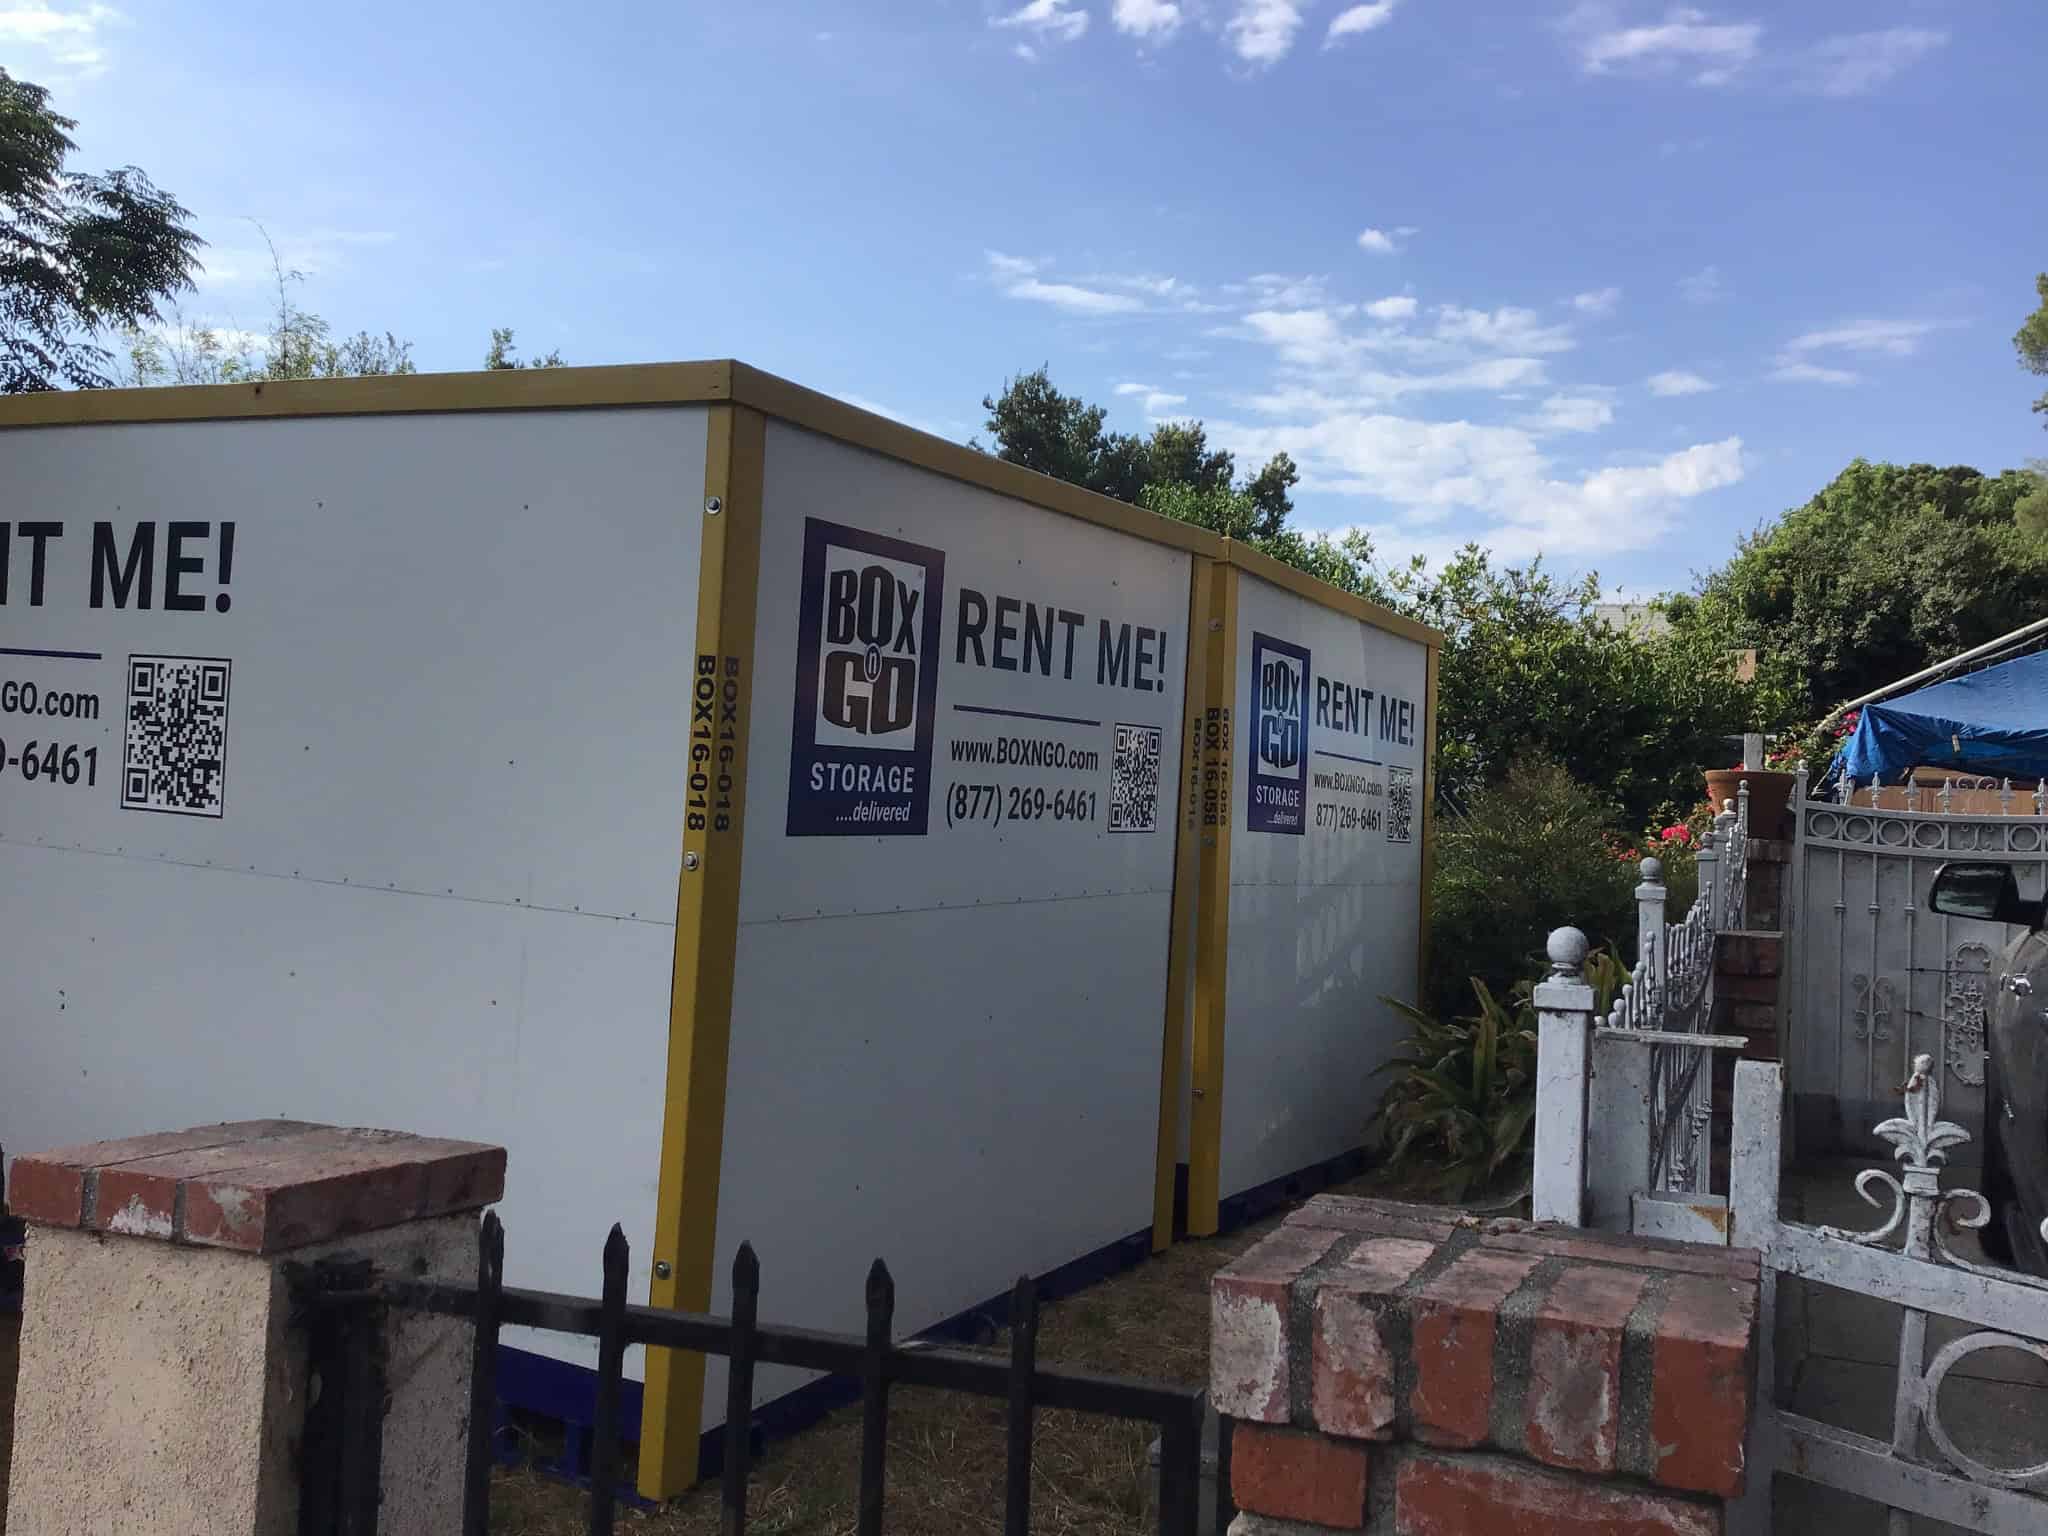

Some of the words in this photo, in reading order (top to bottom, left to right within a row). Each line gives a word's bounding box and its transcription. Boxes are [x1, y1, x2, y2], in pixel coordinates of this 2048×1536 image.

[0, 521, 64, 606] T
[89, 521, 235, 613] ME!
[827, 565, 920, 655] BOX
[955, 587, 1085, 680] RENT
[1097, 619, 1167, 693] ME!
[823, 651, 915, 736] GO
[1261, 660, 1300, 718] BOX
[1316, 675, 1374, 737] RENT
[1380, 694, 1416, 747] ME!
[687, 655, 716, 832] BOX16-018
[714, 656, 740, 833] BOX16-018
[951, 737, 1099, 771] www.BOXNGO.com
[1205, 707, 1221, 751] BOX
[810, 761, 916, 793] STORAGE
[946, 781, 1001, 830] (877)
[1008, 786, 1097, 821] 269-6461
[1256, 784, 1300, 808] STORAGE
[1313, 771, 1383, 796] www.BOXNGO.com
[1340, 805, 1382, 831] 269-6461
